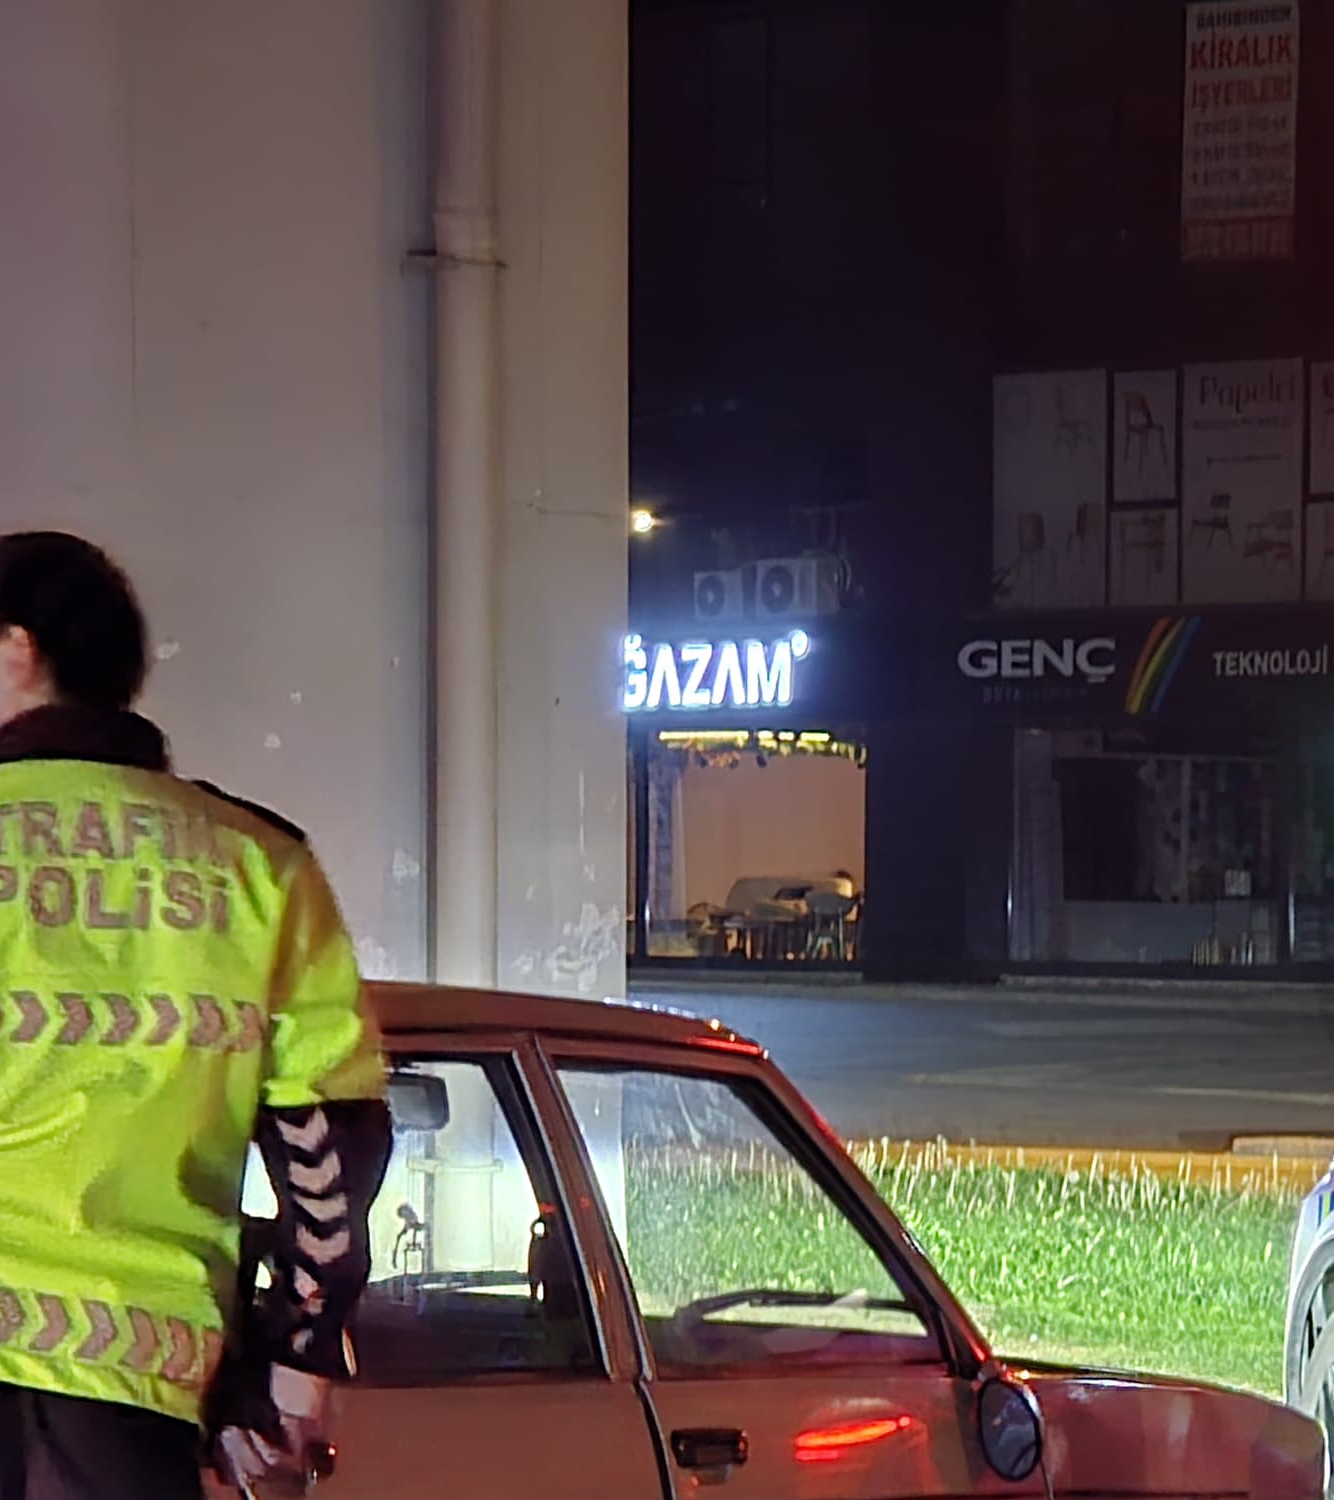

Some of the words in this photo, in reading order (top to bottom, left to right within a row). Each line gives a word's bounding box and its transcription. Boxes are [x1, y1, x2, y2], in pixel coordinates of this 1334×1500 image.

[1189, 31, 1292, 70] KİRALIK
[957, 637, 1116, 684] GENÇ
[1211, 643, 1328, 677] TEKNOLOJİ
